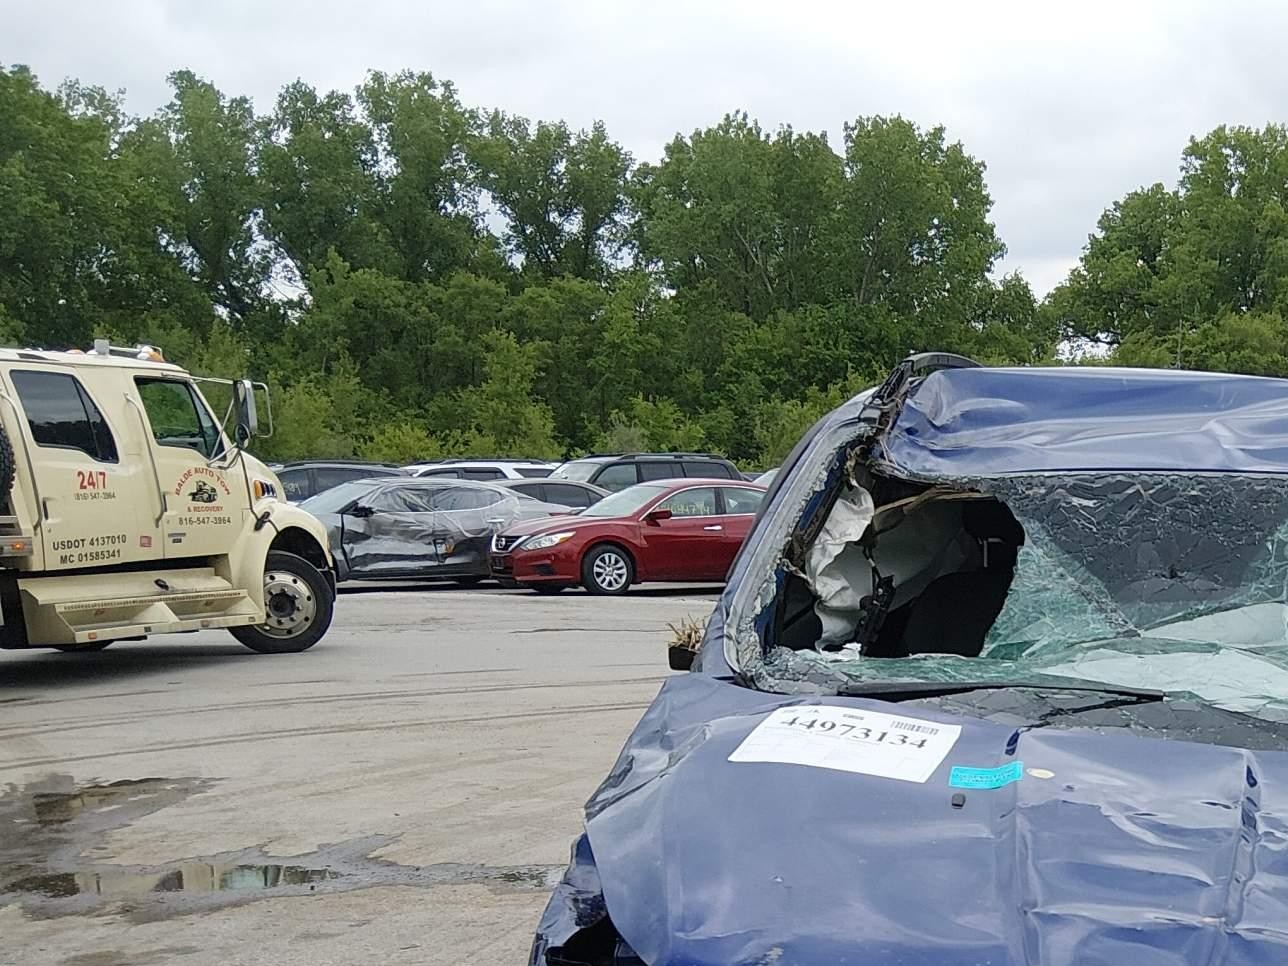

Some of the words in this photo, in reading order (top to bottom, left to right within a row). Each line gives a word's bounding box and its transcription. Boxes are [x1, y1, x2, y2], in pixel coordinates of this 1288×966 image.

[194, 467, 214, 478] AUTO
[193, 505, 224, 513] RECOVERY
[178, 516, 232, 526] 816-547-3964
[52, 538, 86, 551] USDOT
[89, 534, 127, 547] 4137010
[60, 554, 75, 565] MC
[77, 548, 121, 562] 01585341
[780, 715, 928, 750] 44973134
